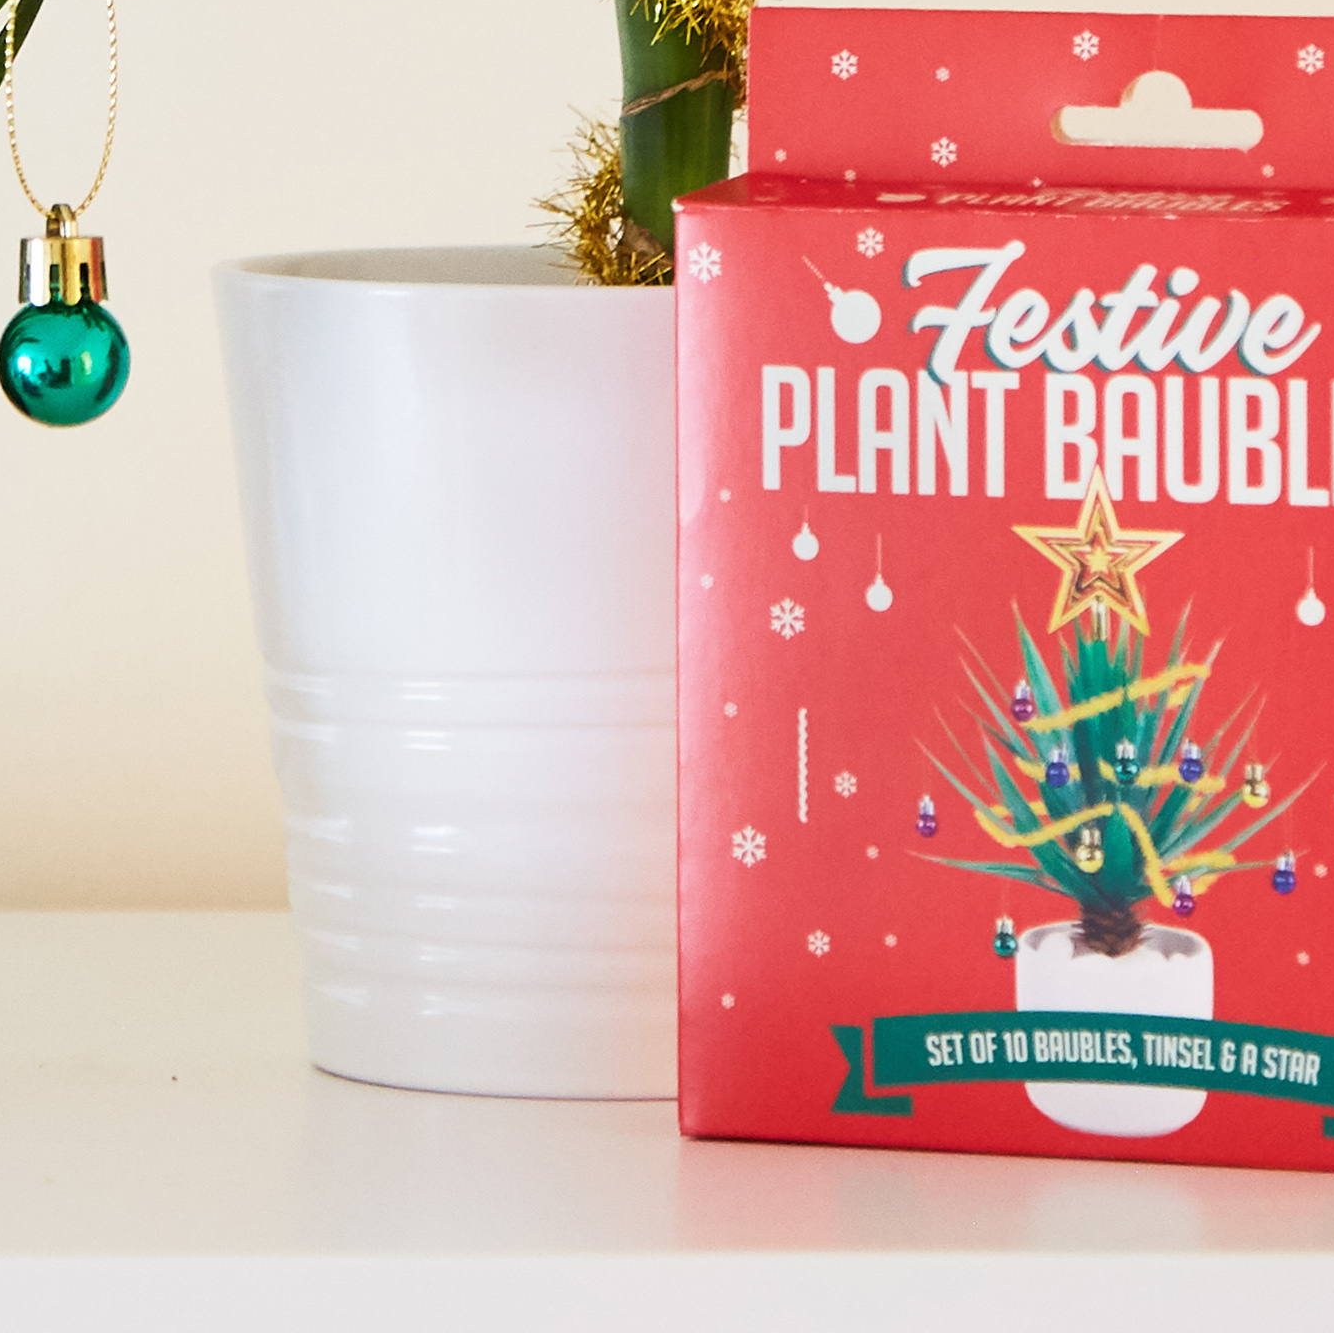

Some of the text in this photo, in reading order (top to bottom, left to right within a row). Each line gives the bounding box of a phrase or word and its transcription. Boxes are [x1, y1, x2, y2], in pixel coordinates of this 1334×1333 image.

[903, 240, 1322, 385] Festive
[761, 365, 1020, 497] PLANT
[925, 1029, 1321, 1087] SET OF 10 BAUBLES, TINSEL & A STAR
